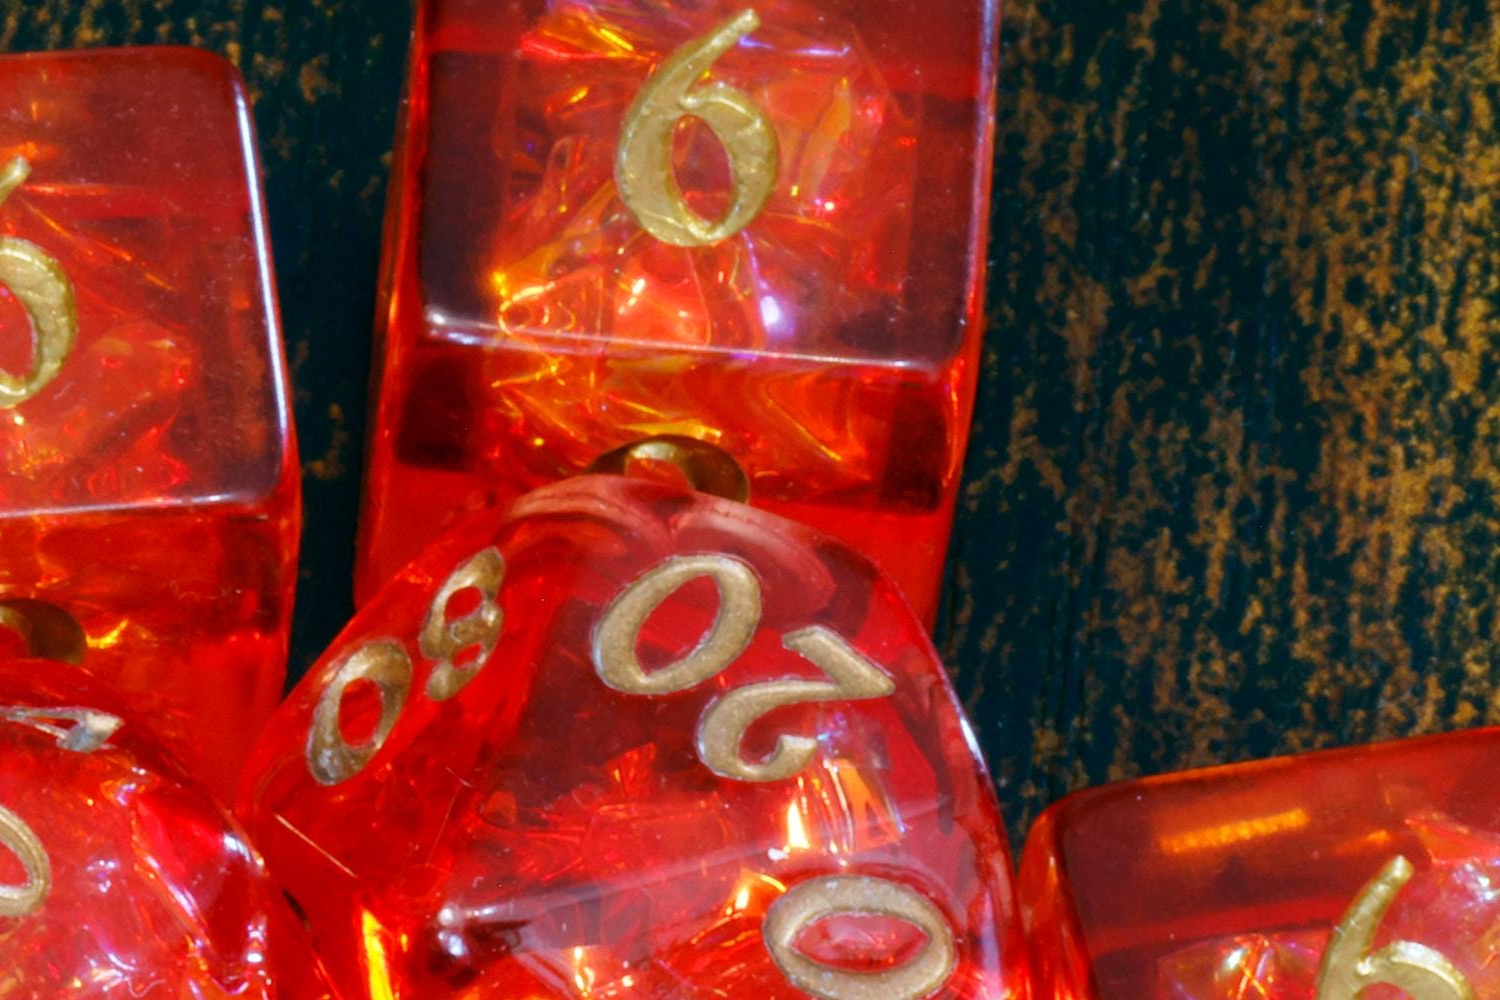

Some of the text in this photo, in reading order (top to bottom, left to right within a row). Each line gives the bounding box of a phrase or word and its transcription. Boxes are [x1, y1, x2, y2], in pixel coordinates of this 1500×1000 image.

[615, 8, 779, 247] 6
[306, 546, 504, 787] 80
[591, 552, 897, 783] 20
